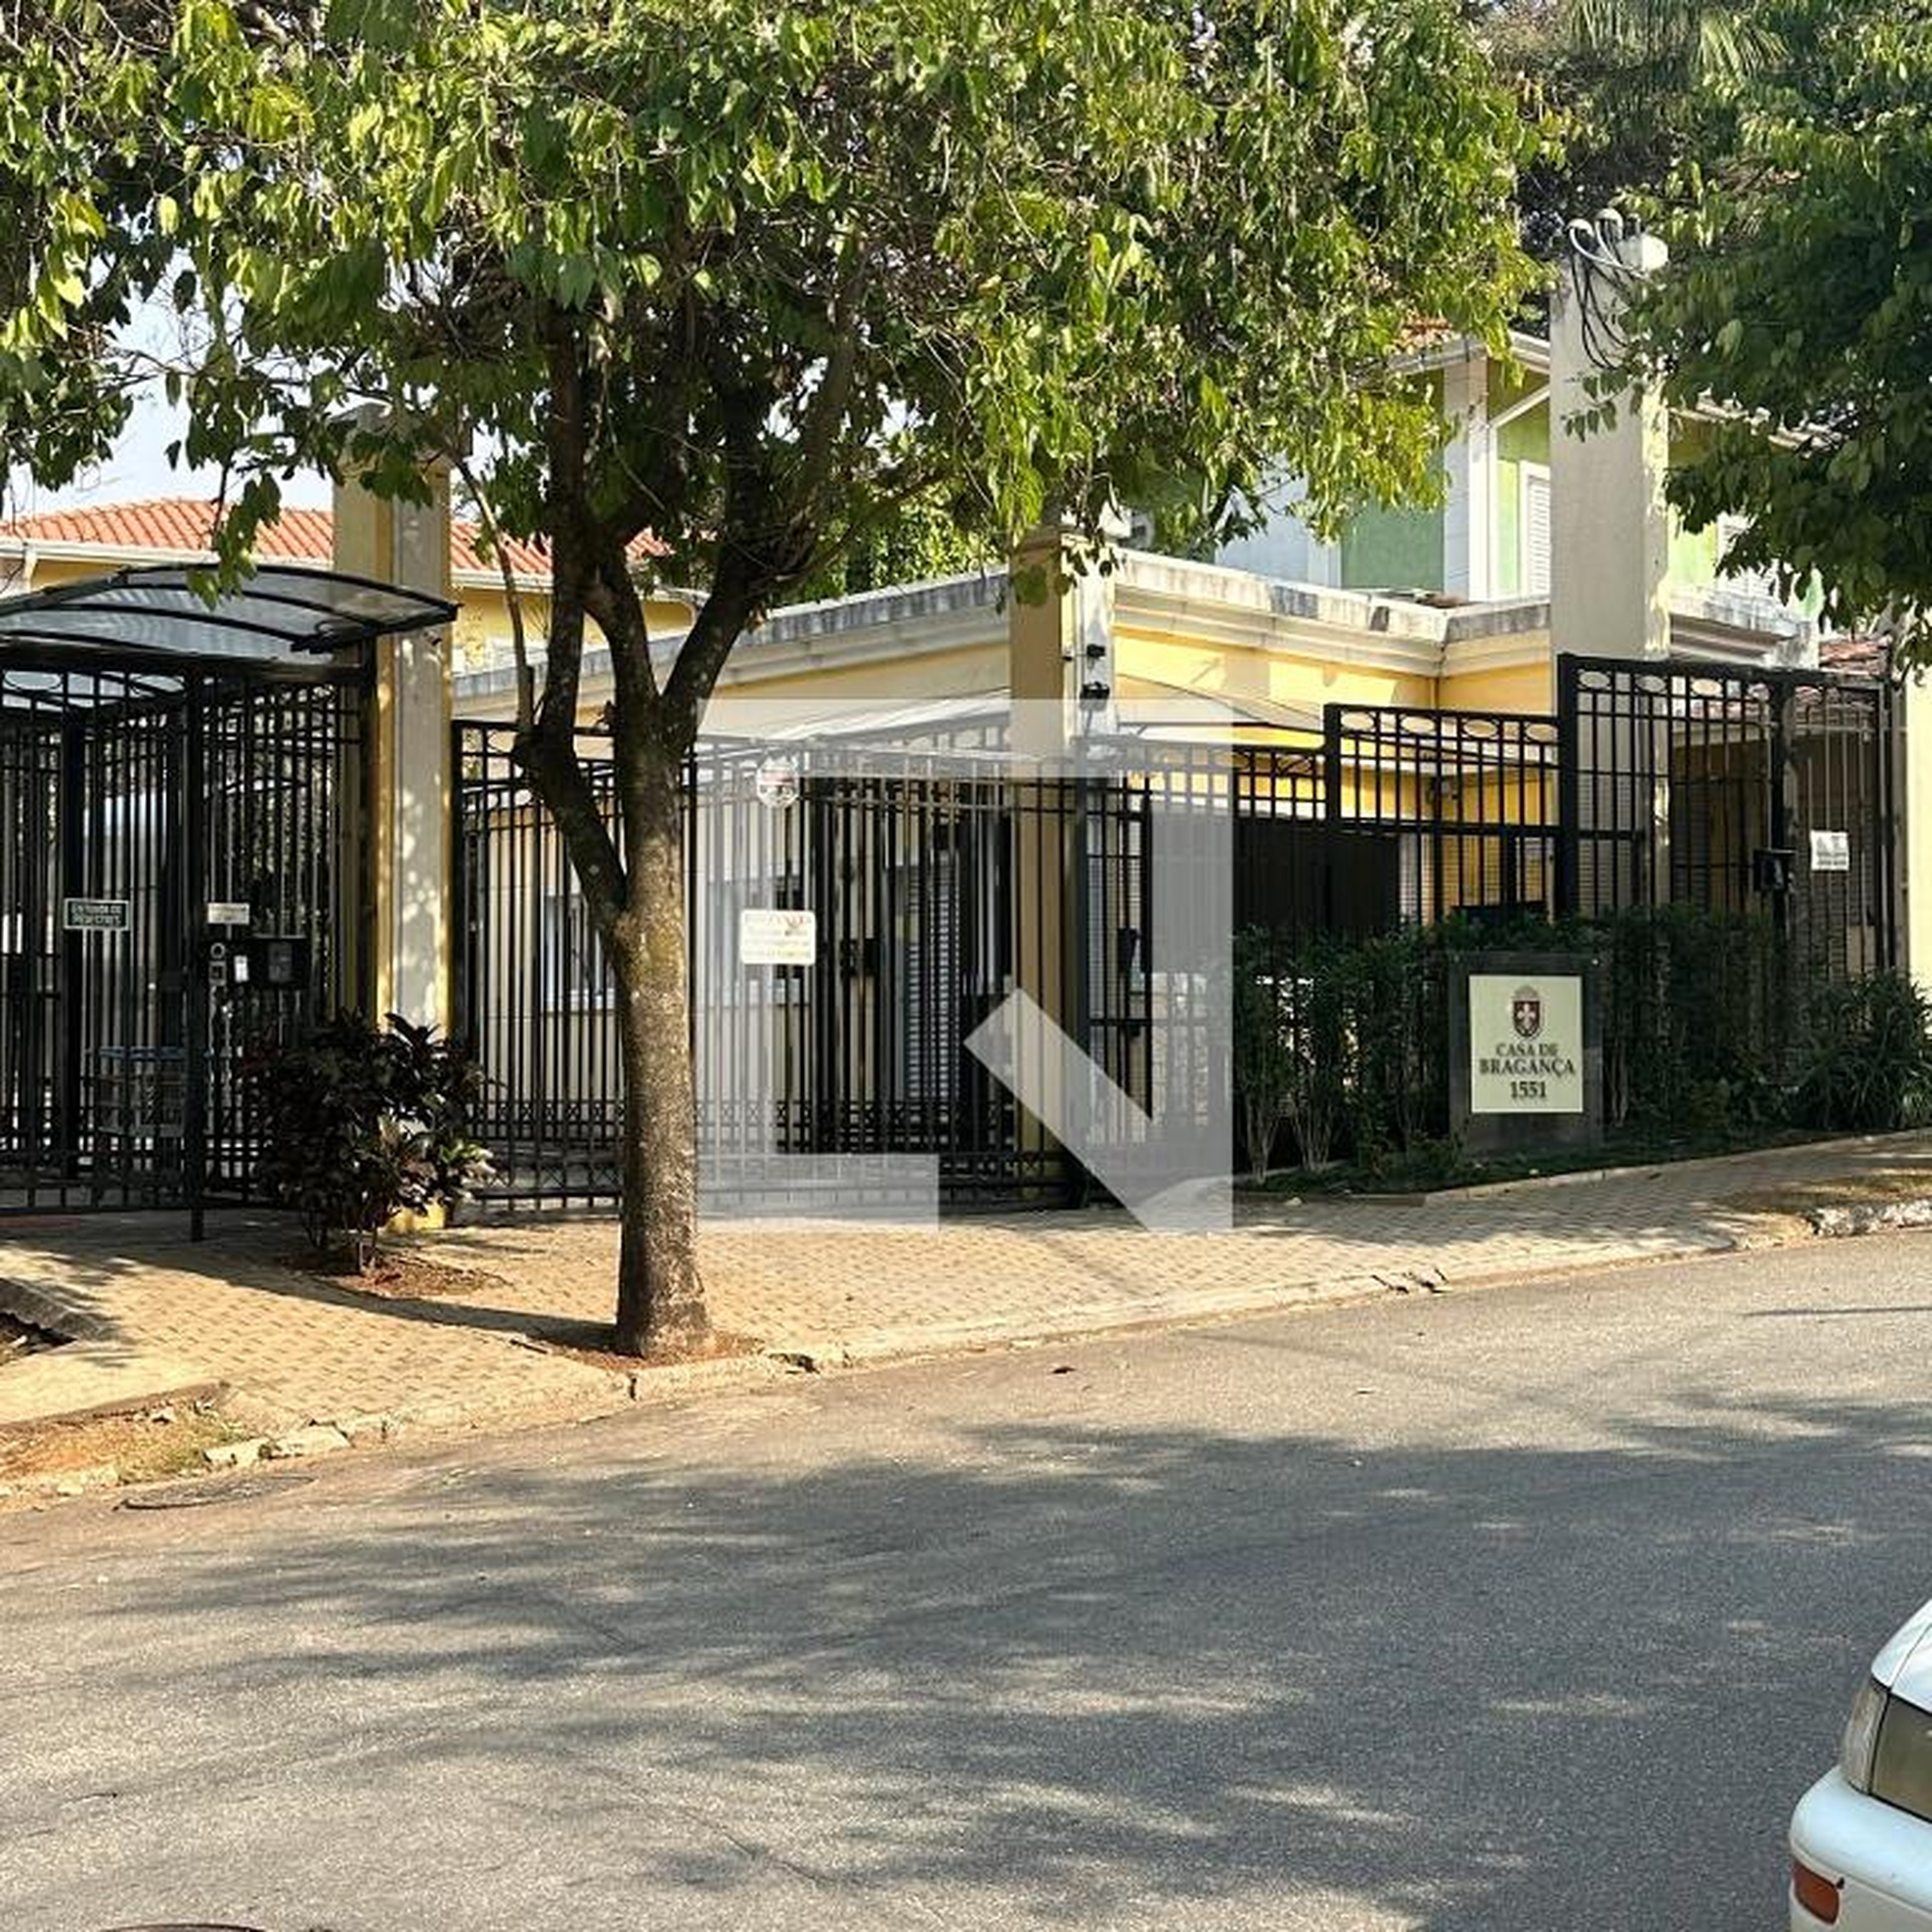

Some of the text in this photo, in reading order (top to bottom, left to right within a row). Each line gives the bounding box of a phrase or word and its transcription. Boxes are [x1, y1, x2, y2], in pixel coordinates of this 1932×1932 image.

[1496, 1043, 1559, 1057] CASA DE
[1480, 1059, 1575, 1078] BRAGANÇA
[1510, 1081, 1546, 1099] 1551
